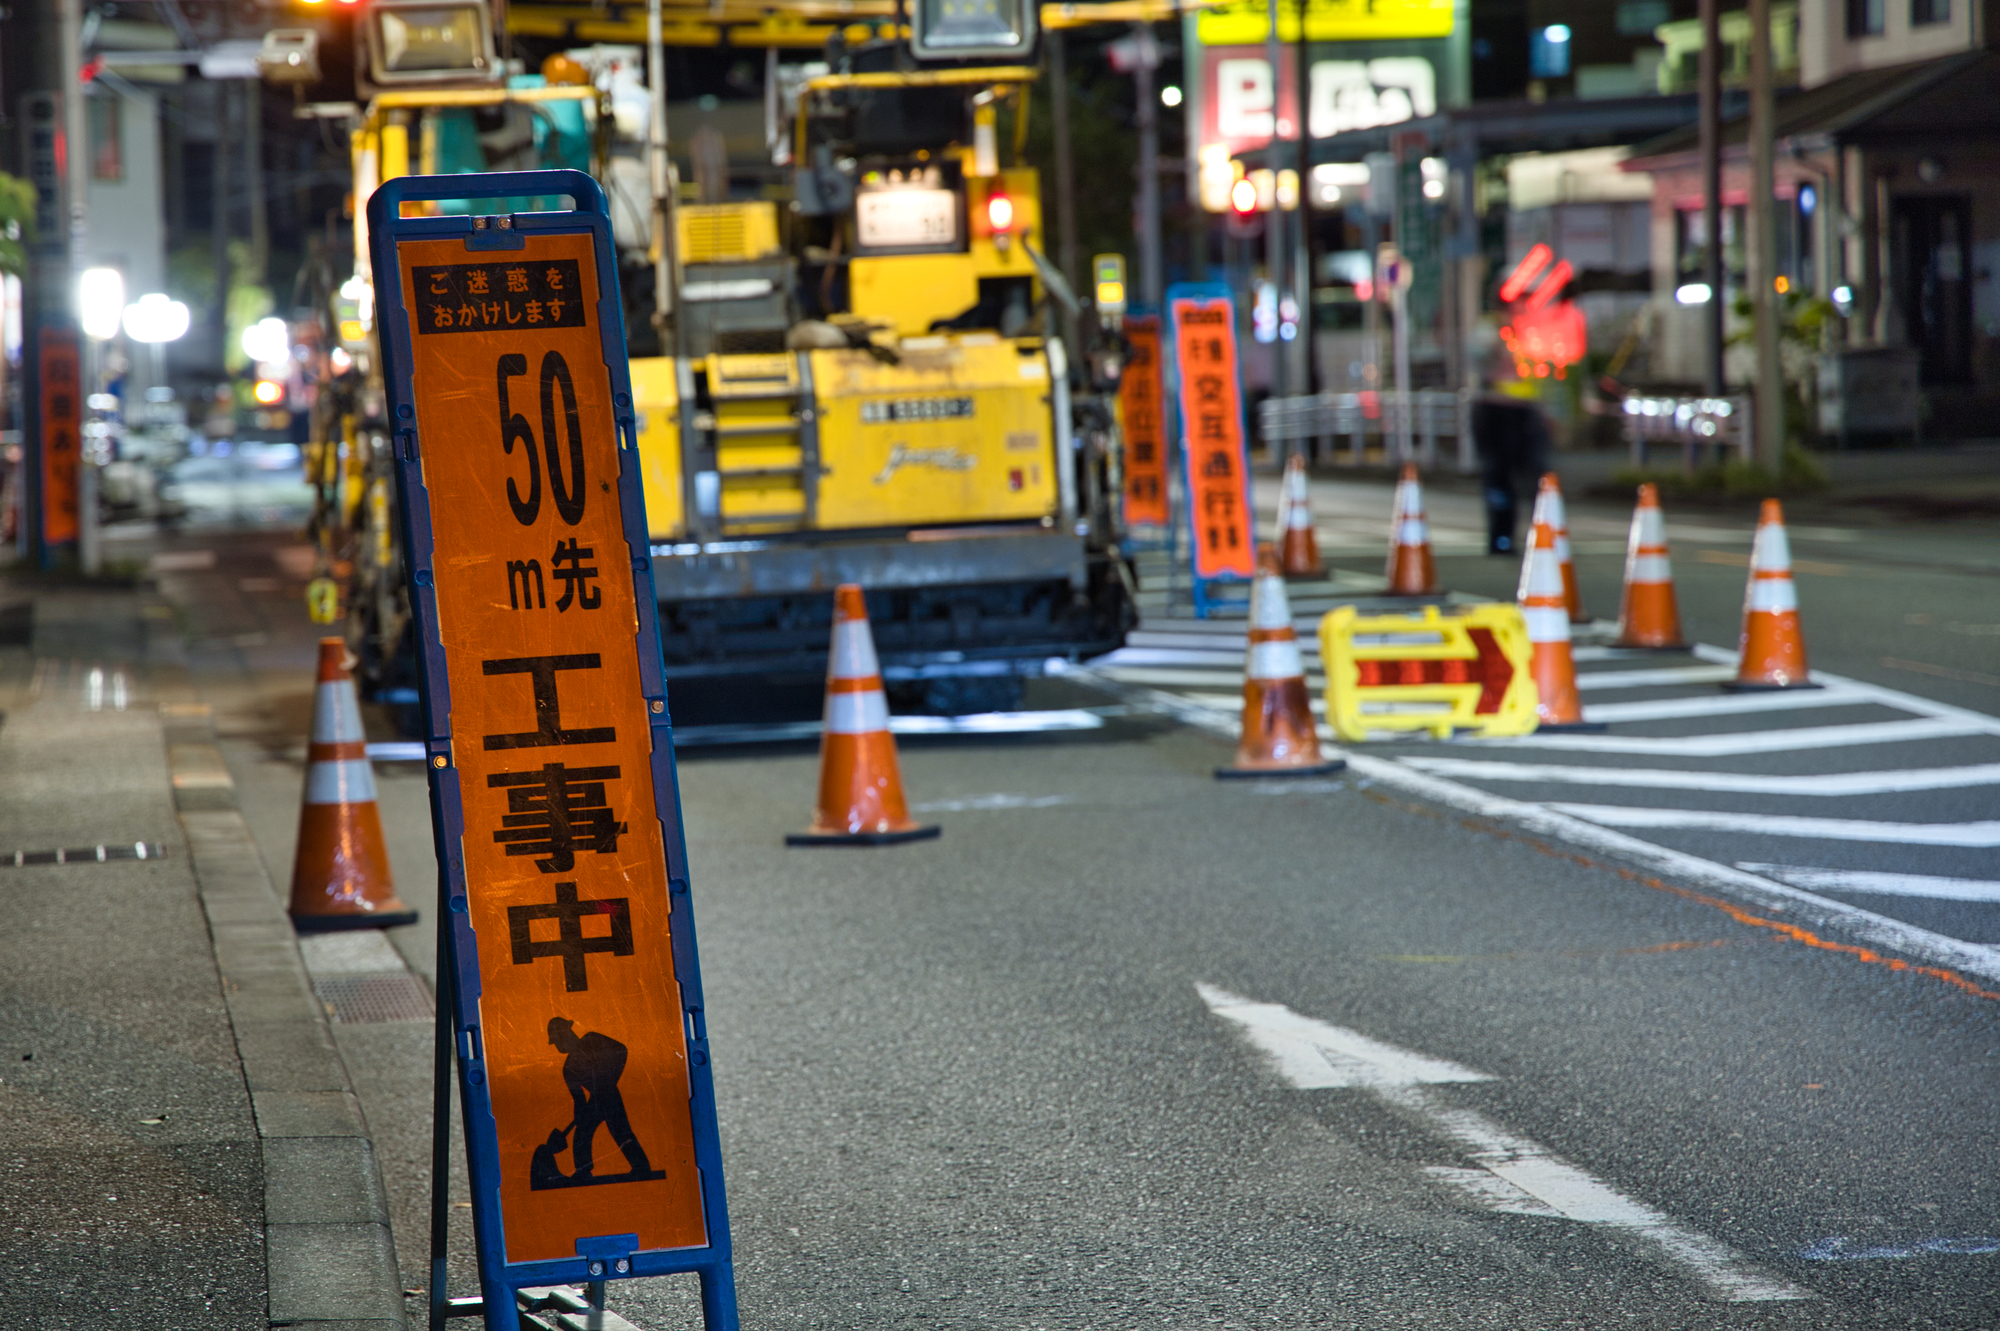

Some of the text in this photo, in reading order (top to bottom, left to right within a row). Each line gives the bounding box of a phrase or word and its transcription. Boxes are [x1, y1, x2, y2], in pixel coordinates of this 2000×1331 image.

[430, 267, 564, 295] ご迷惑を
[434, 299, 566, 327] おかけします
[497, 350, 586, 526] 50
[507, 538, 602, 613] m先
[482, 653, 635, 992] 工事中
